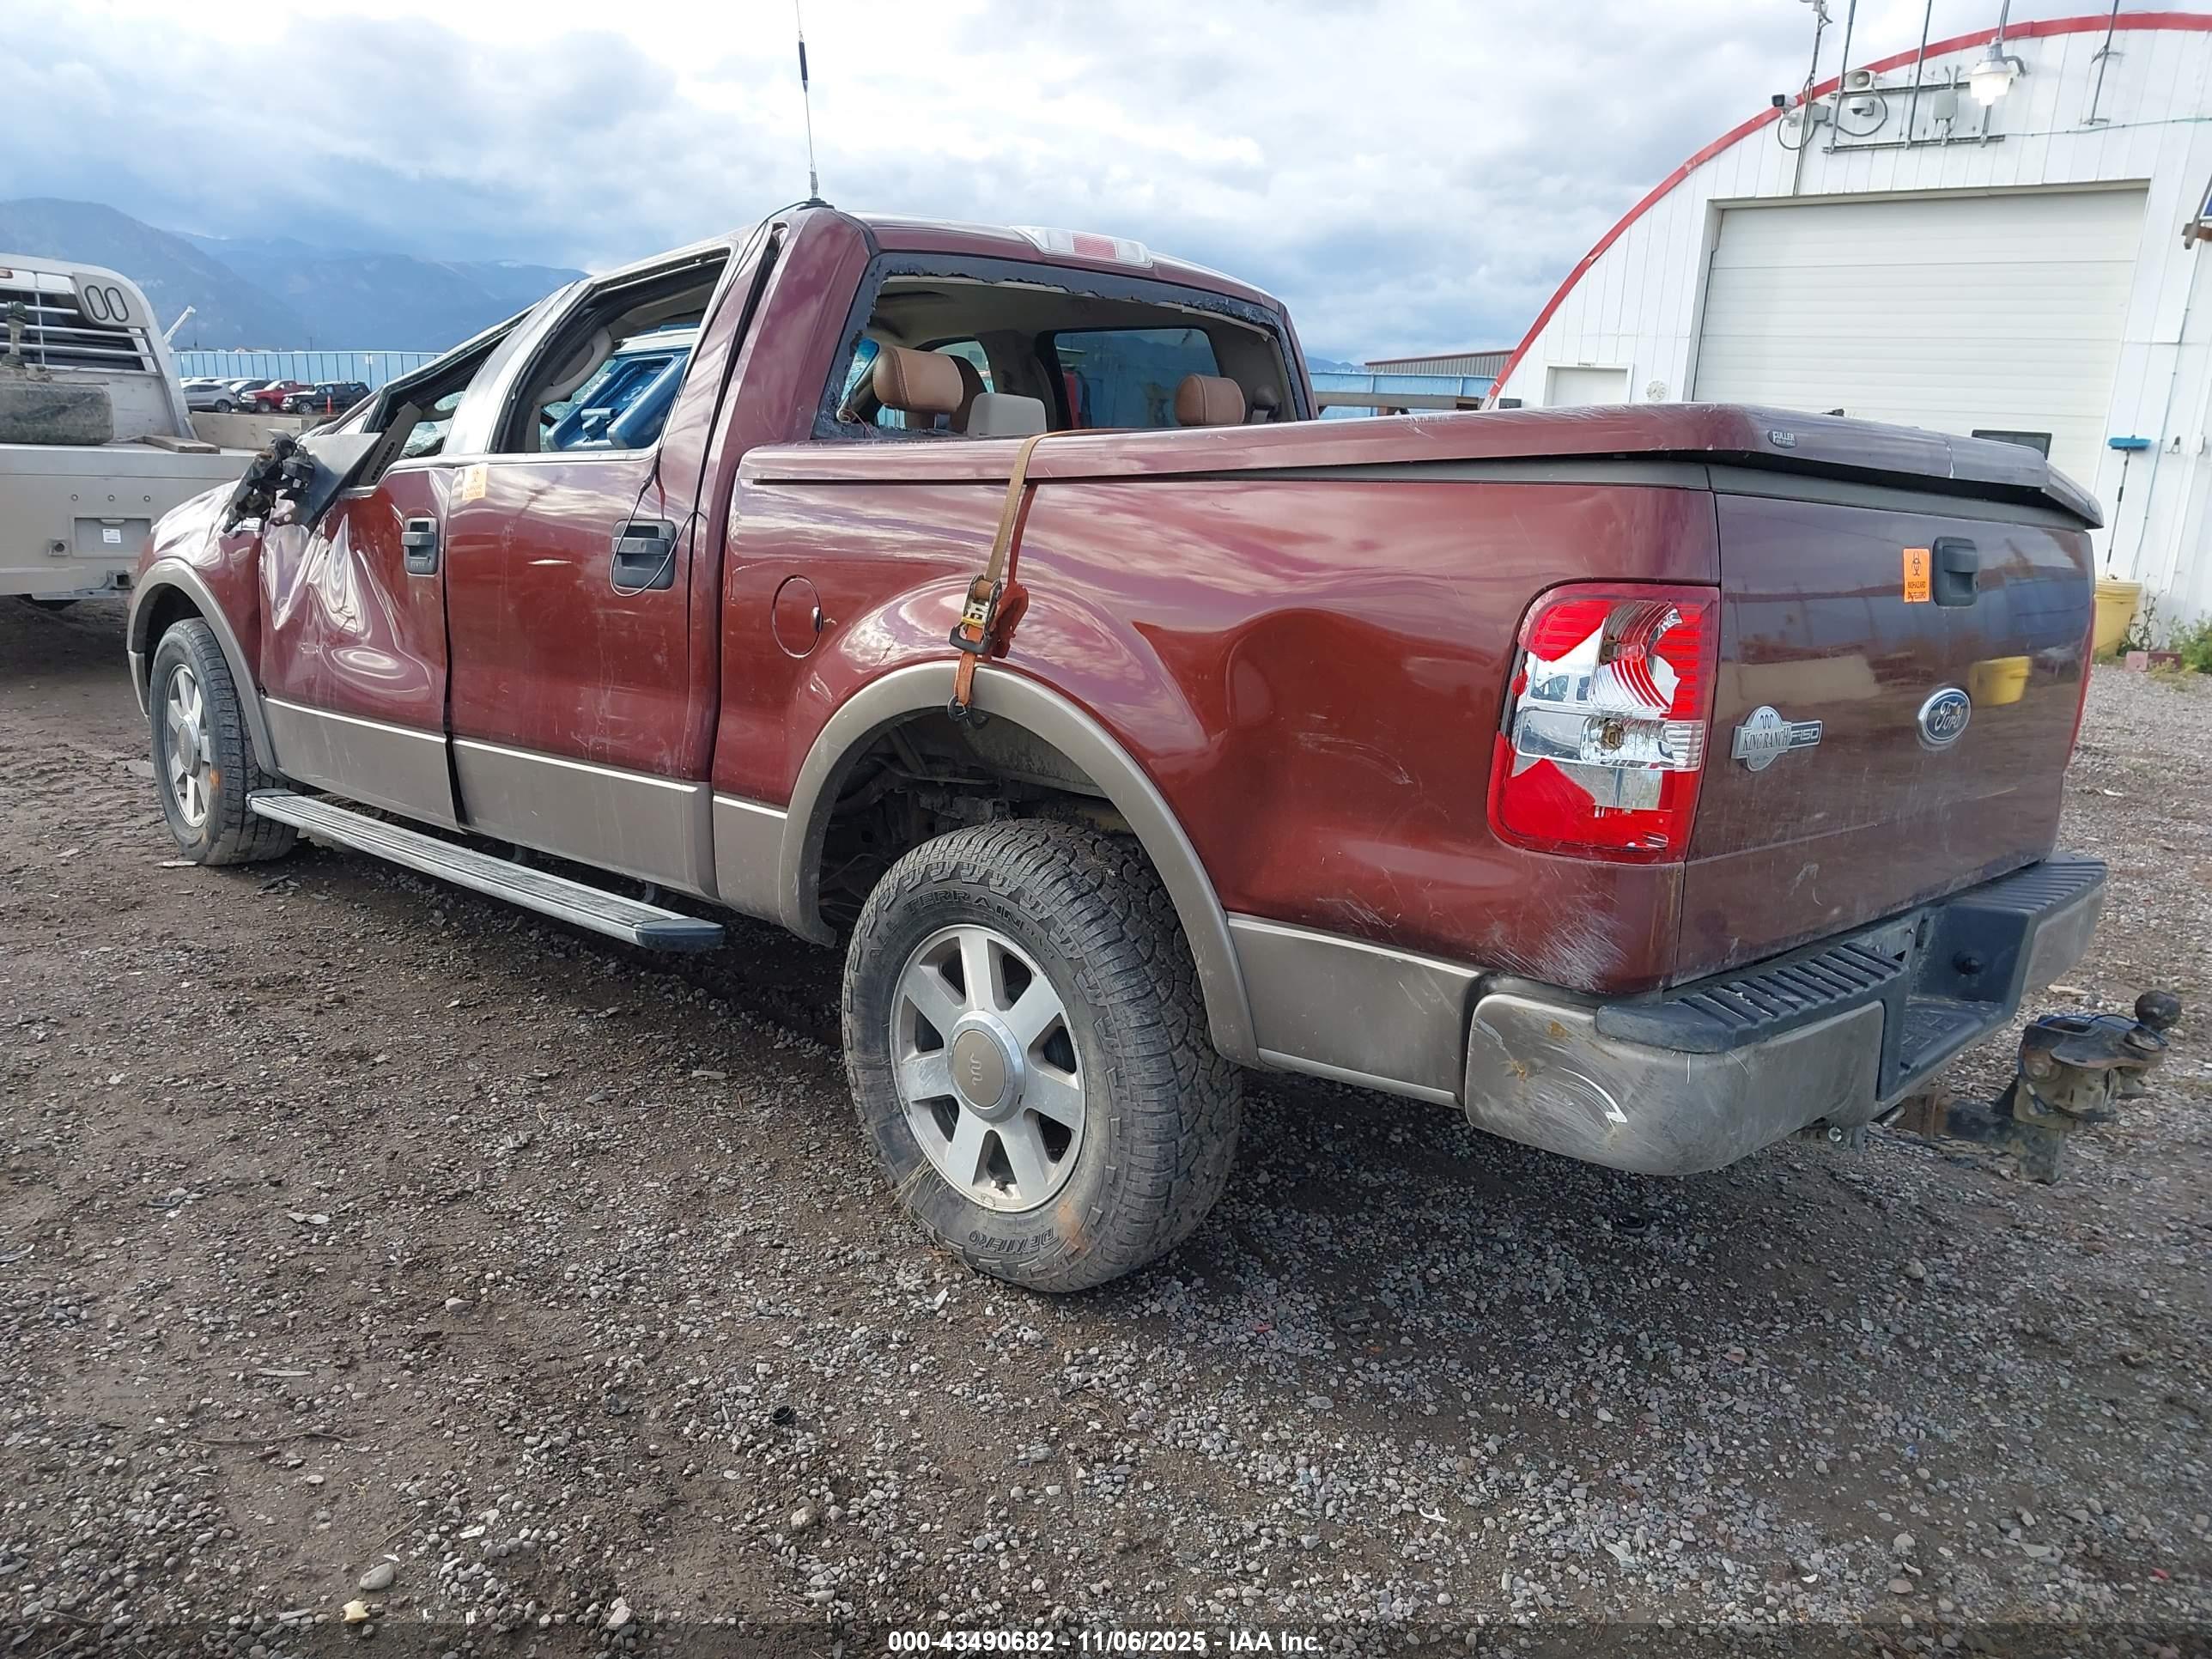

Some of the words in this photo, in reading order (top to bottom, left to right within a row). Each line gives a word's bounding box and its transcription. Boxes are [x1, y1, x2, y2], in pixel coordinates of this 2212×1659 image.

[1935, 701, 1964, 731] Ford
[1743, 732, 1763, 750] KING
[1763, 727, 1790, 749] RANCH
[902, 889, 1024, 930] TERRAIN
[969, 1225, 1059, 1255] DEXTERO
